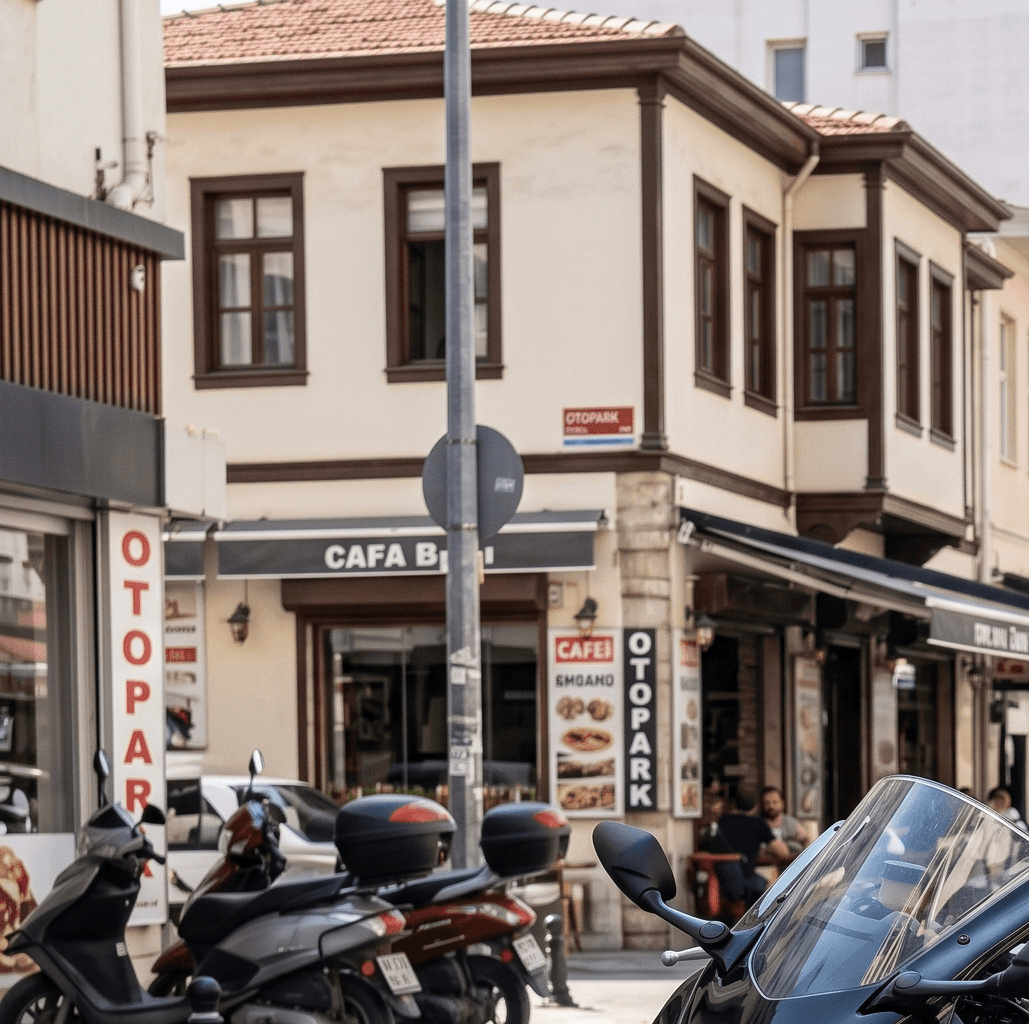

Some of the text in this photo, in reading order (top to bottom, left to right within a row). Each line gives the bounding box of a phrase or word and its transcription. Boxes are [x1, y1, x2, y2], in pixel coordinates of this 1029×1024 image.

[324, 543, 407, 569] CAFA
[120, 530, 154, 879] OTOPAR
[628, 631, 653, 808] OTOPARK
